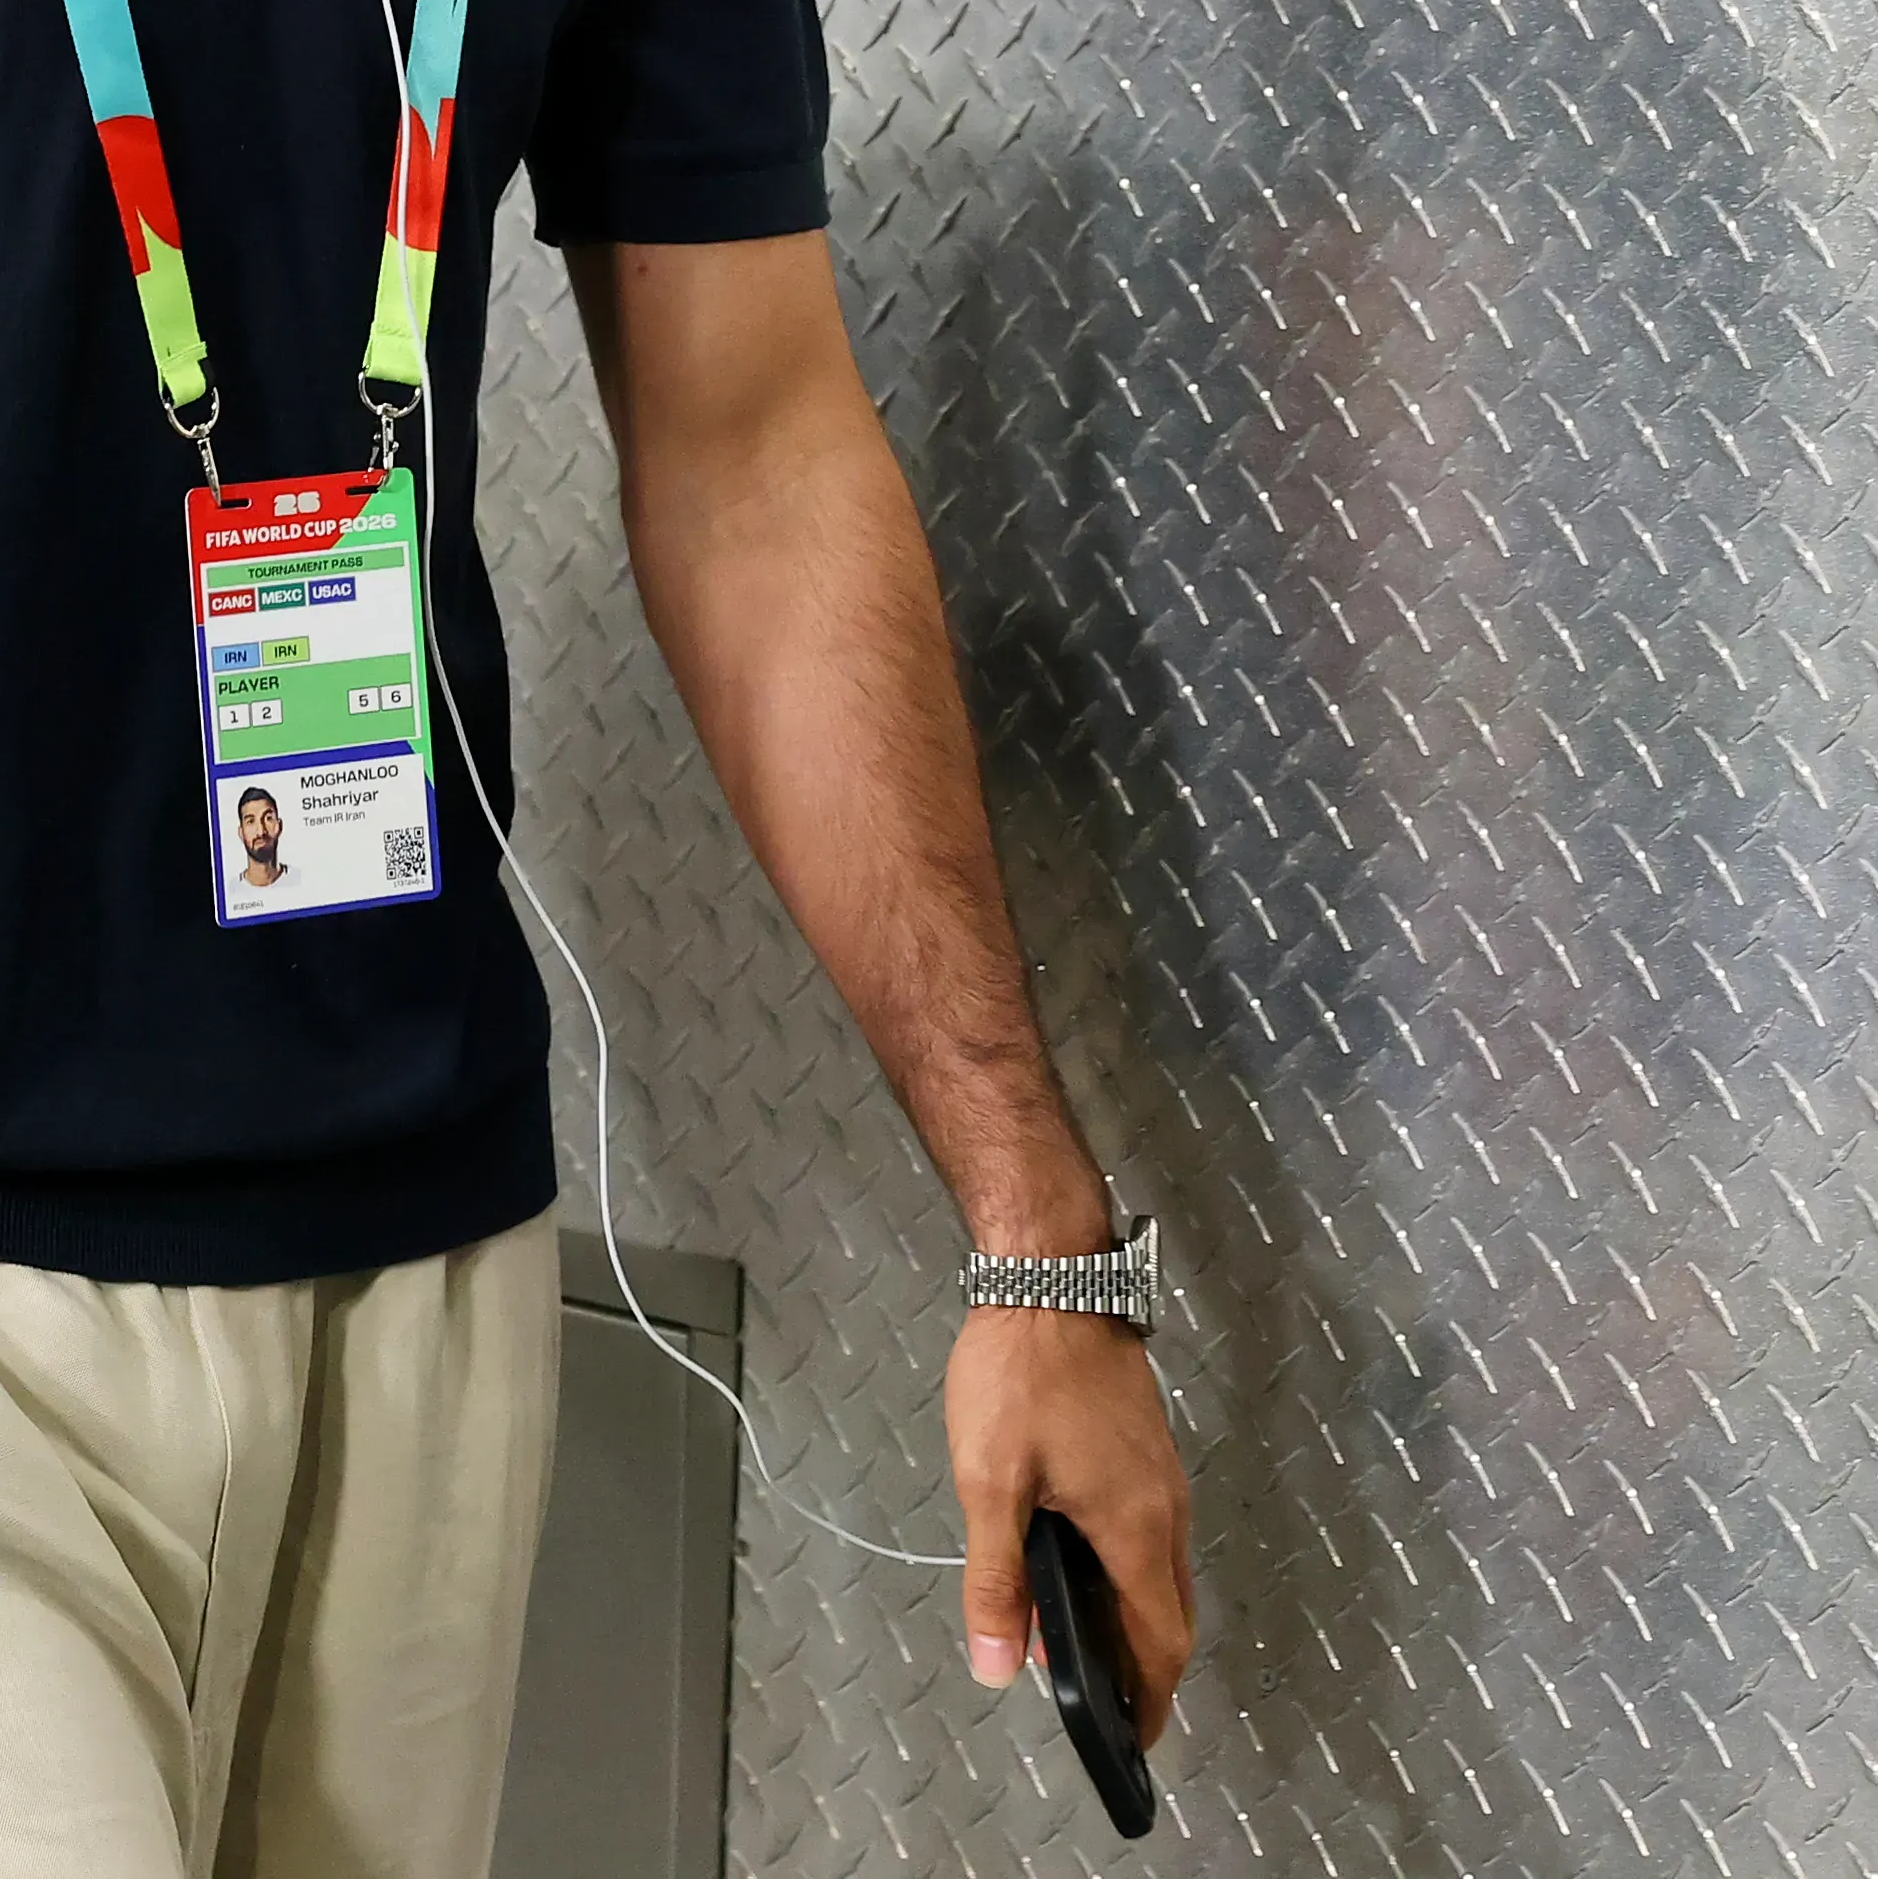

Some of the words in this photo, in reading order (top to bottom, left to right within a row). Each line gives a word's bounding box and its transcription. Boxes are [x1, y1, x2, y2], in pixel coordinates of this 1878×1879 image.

[205, 529, 241, 549] FIFA
[242, 523, 302, 544] WORLD
[303, 519, 337, 536] CUP
[339, 513, 397, 534] 2026
[248, 560, 329, 579] TOURNAMENT
[331, 555, 364, 568] PASS
[211, 594, 253, 611] CANC
[261, 588, 303, 605] MEXC
[312, 583, 352, 599] USAC
[224, 650, 247, 664] IRN
[274, 644, 297, 658] IRN
[218, 676, 280, 695] PLAYER
[358, 694, 369, 708] 5
[390, 690, 401, 703] 6
[261, 706, 272, 720] 2
[301, 765, 399, 789] MOGHANLOO
[302, 790, 379, 810] Shahriyar
[303, 815, 333, 827] Team
[345, 810, 366, 821] Iran
